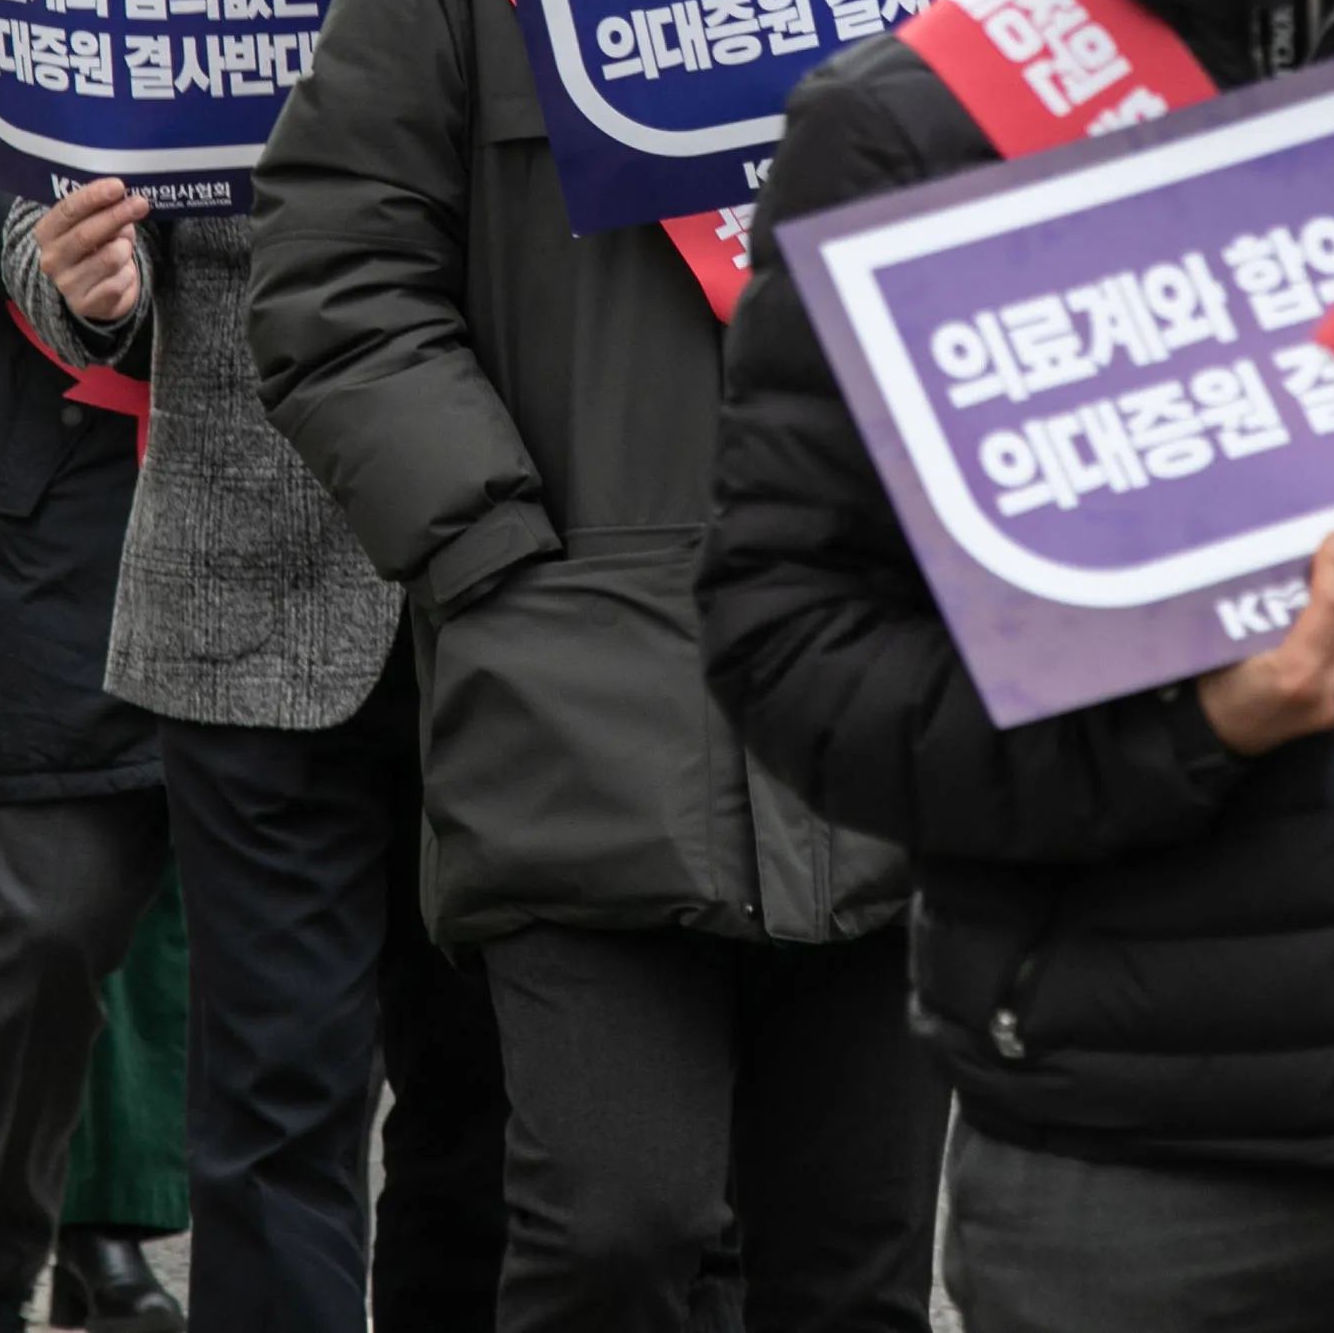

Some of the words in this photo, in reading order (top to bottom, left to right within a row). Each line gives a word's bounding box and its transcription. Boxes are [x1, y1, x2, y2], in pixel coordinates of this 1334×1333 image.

[124, 31, 321, 100] 결사반대
[931, 251, 1238, 408] 의료계와
[979, 357, 1291, 517] 의대증원
